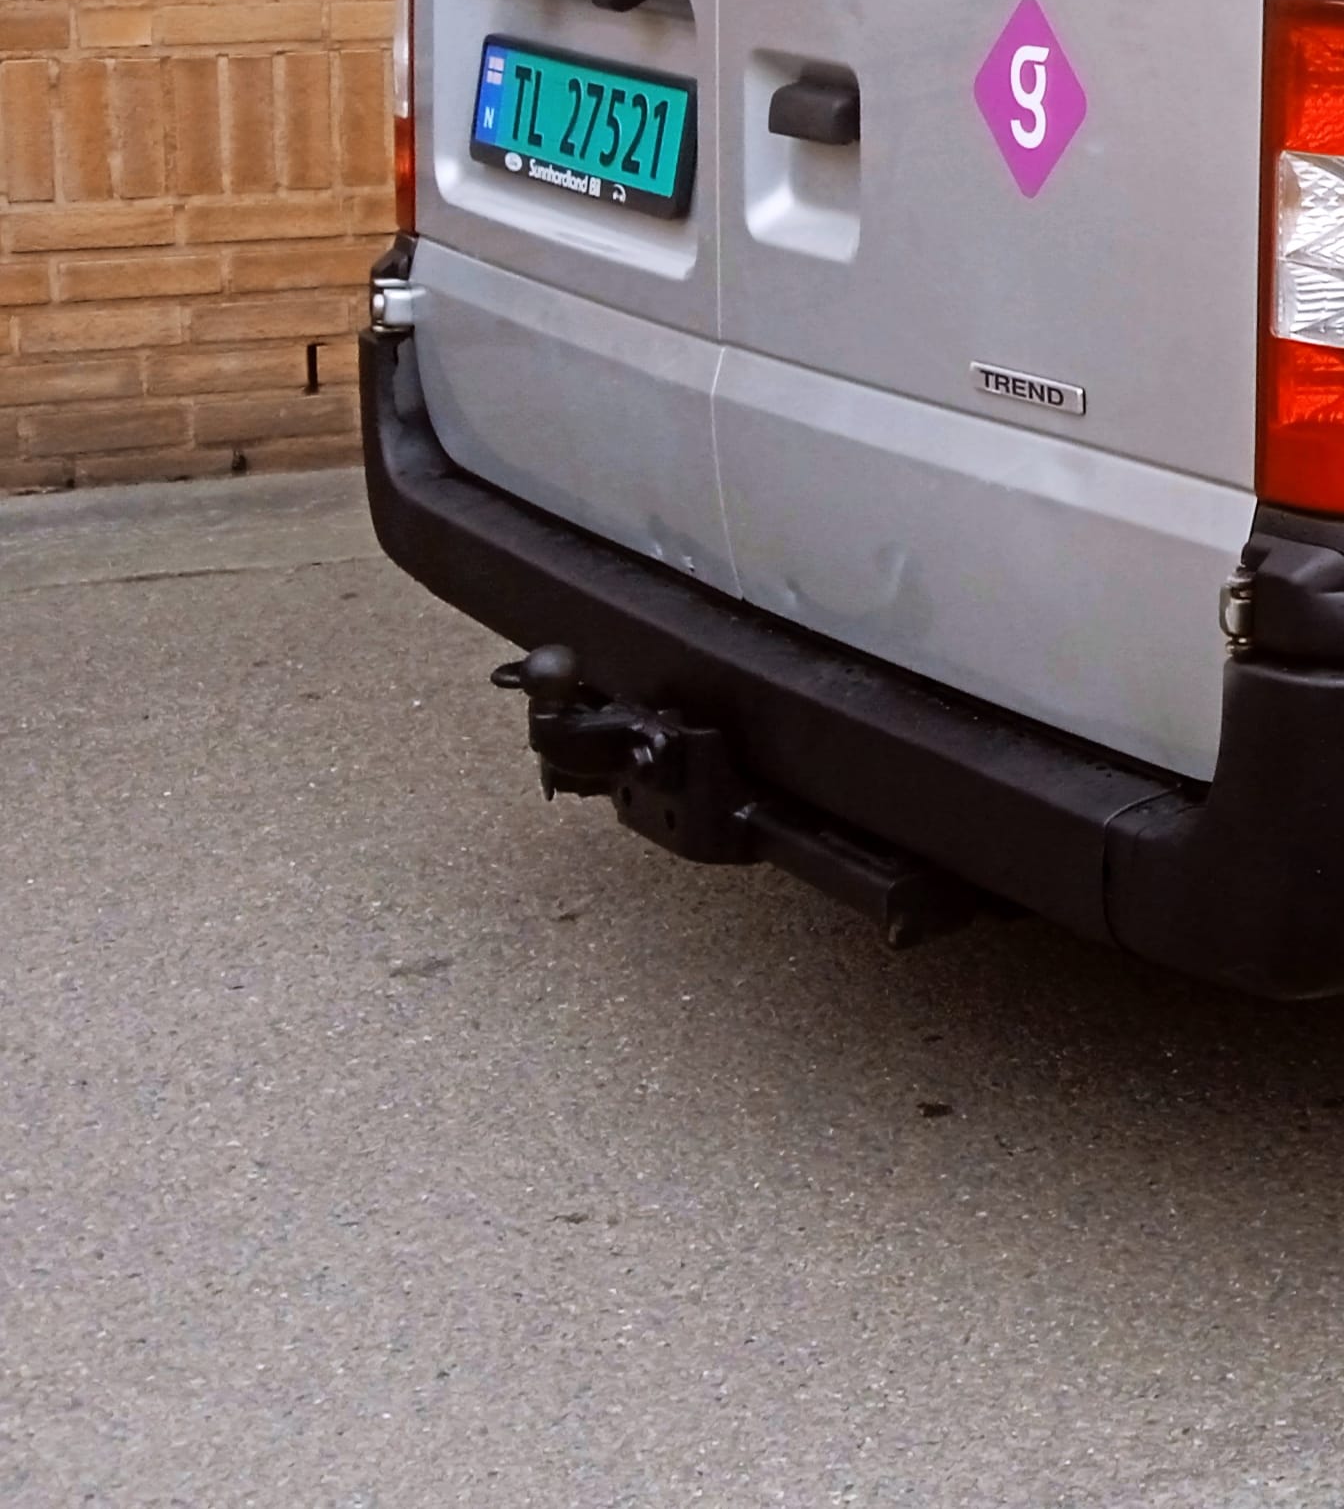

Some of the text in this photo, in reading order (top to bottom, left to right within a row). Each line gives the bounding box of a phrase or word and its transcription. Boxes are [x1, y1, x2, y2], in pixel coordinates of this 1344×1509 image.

[483, 107, 496, 130] N
[512, 65, 669, 180] TL 27521
[528, 158, 589, 194] Sunnhordland
[979, 369, 1065, 407] TREND
